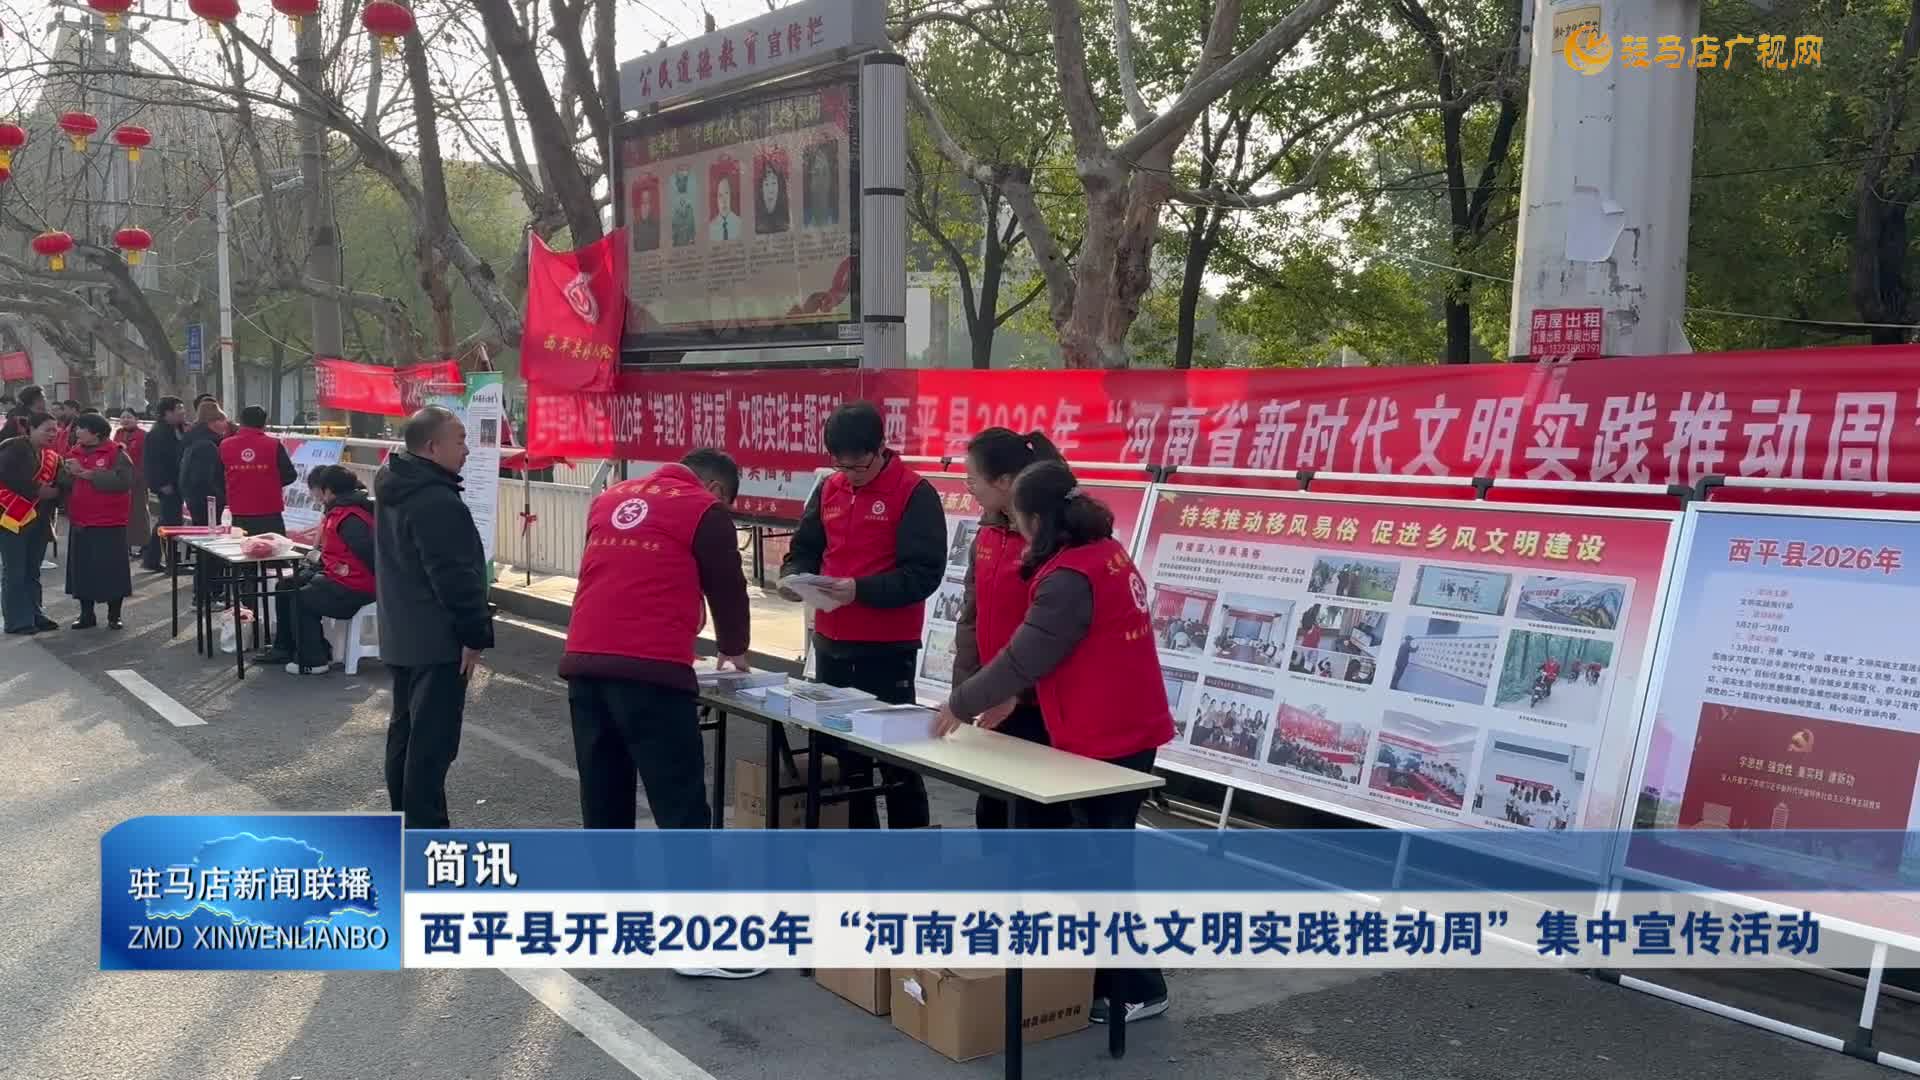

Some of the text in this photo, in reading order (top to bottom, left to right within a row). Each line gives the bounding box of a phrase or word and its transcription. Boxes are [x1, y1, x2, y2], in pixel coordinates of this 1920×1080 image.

[639, 16, 825, 97] 公民道德教育宣传栏
[1534, 312, 1600, 328] 房屋出租
[1179, 504, 1607, 563] 持续推动移风易俗 促进乡风文明建设
[1727, 538, 1903, 575] 西平县2026年
